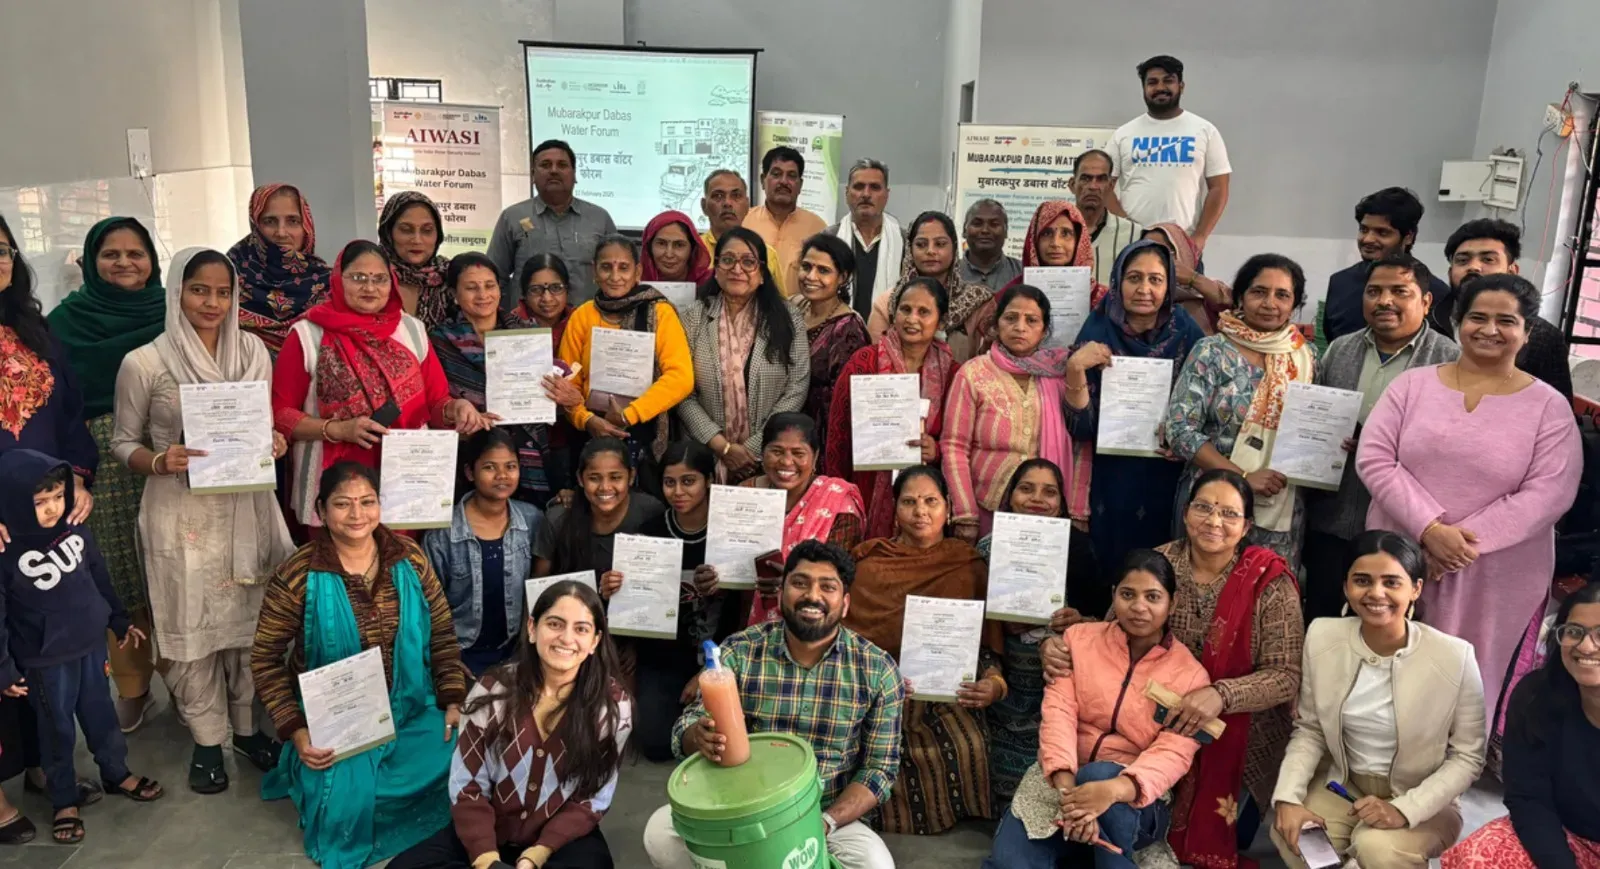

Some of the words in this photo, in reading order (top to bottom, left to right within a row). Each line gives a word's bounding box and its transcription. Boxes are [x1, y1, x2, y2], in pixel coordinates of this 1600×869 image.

[547, 106, 601, 121] Mubarakpur
[603, 109, 632, 121] Dabas
[407, 128, 480, 145] AIWASI
[561, 124, 588, 136] Water
[590, 125, 619, 137] Forum
[1131, 136, 1196, 163] NIKE
[967, 152, 1022, 165] MUBARAKPUR
[1024, 154, 1052, 166] DABAS
[458, 169, 487, 178] Dabas
[415, 179, 441, 188] Water
[443, 180, 473, 189] Forum
[977, 177, 1020, 190] मुबारकपुर
[1023, 177, 1049, 189] डबास
[1051, 176, 1069, 189] वॉट
[453, 202, 476, 212] डबास
[18, 534, 84, 590] SUP
[788, 841, 817, 869] WOW
